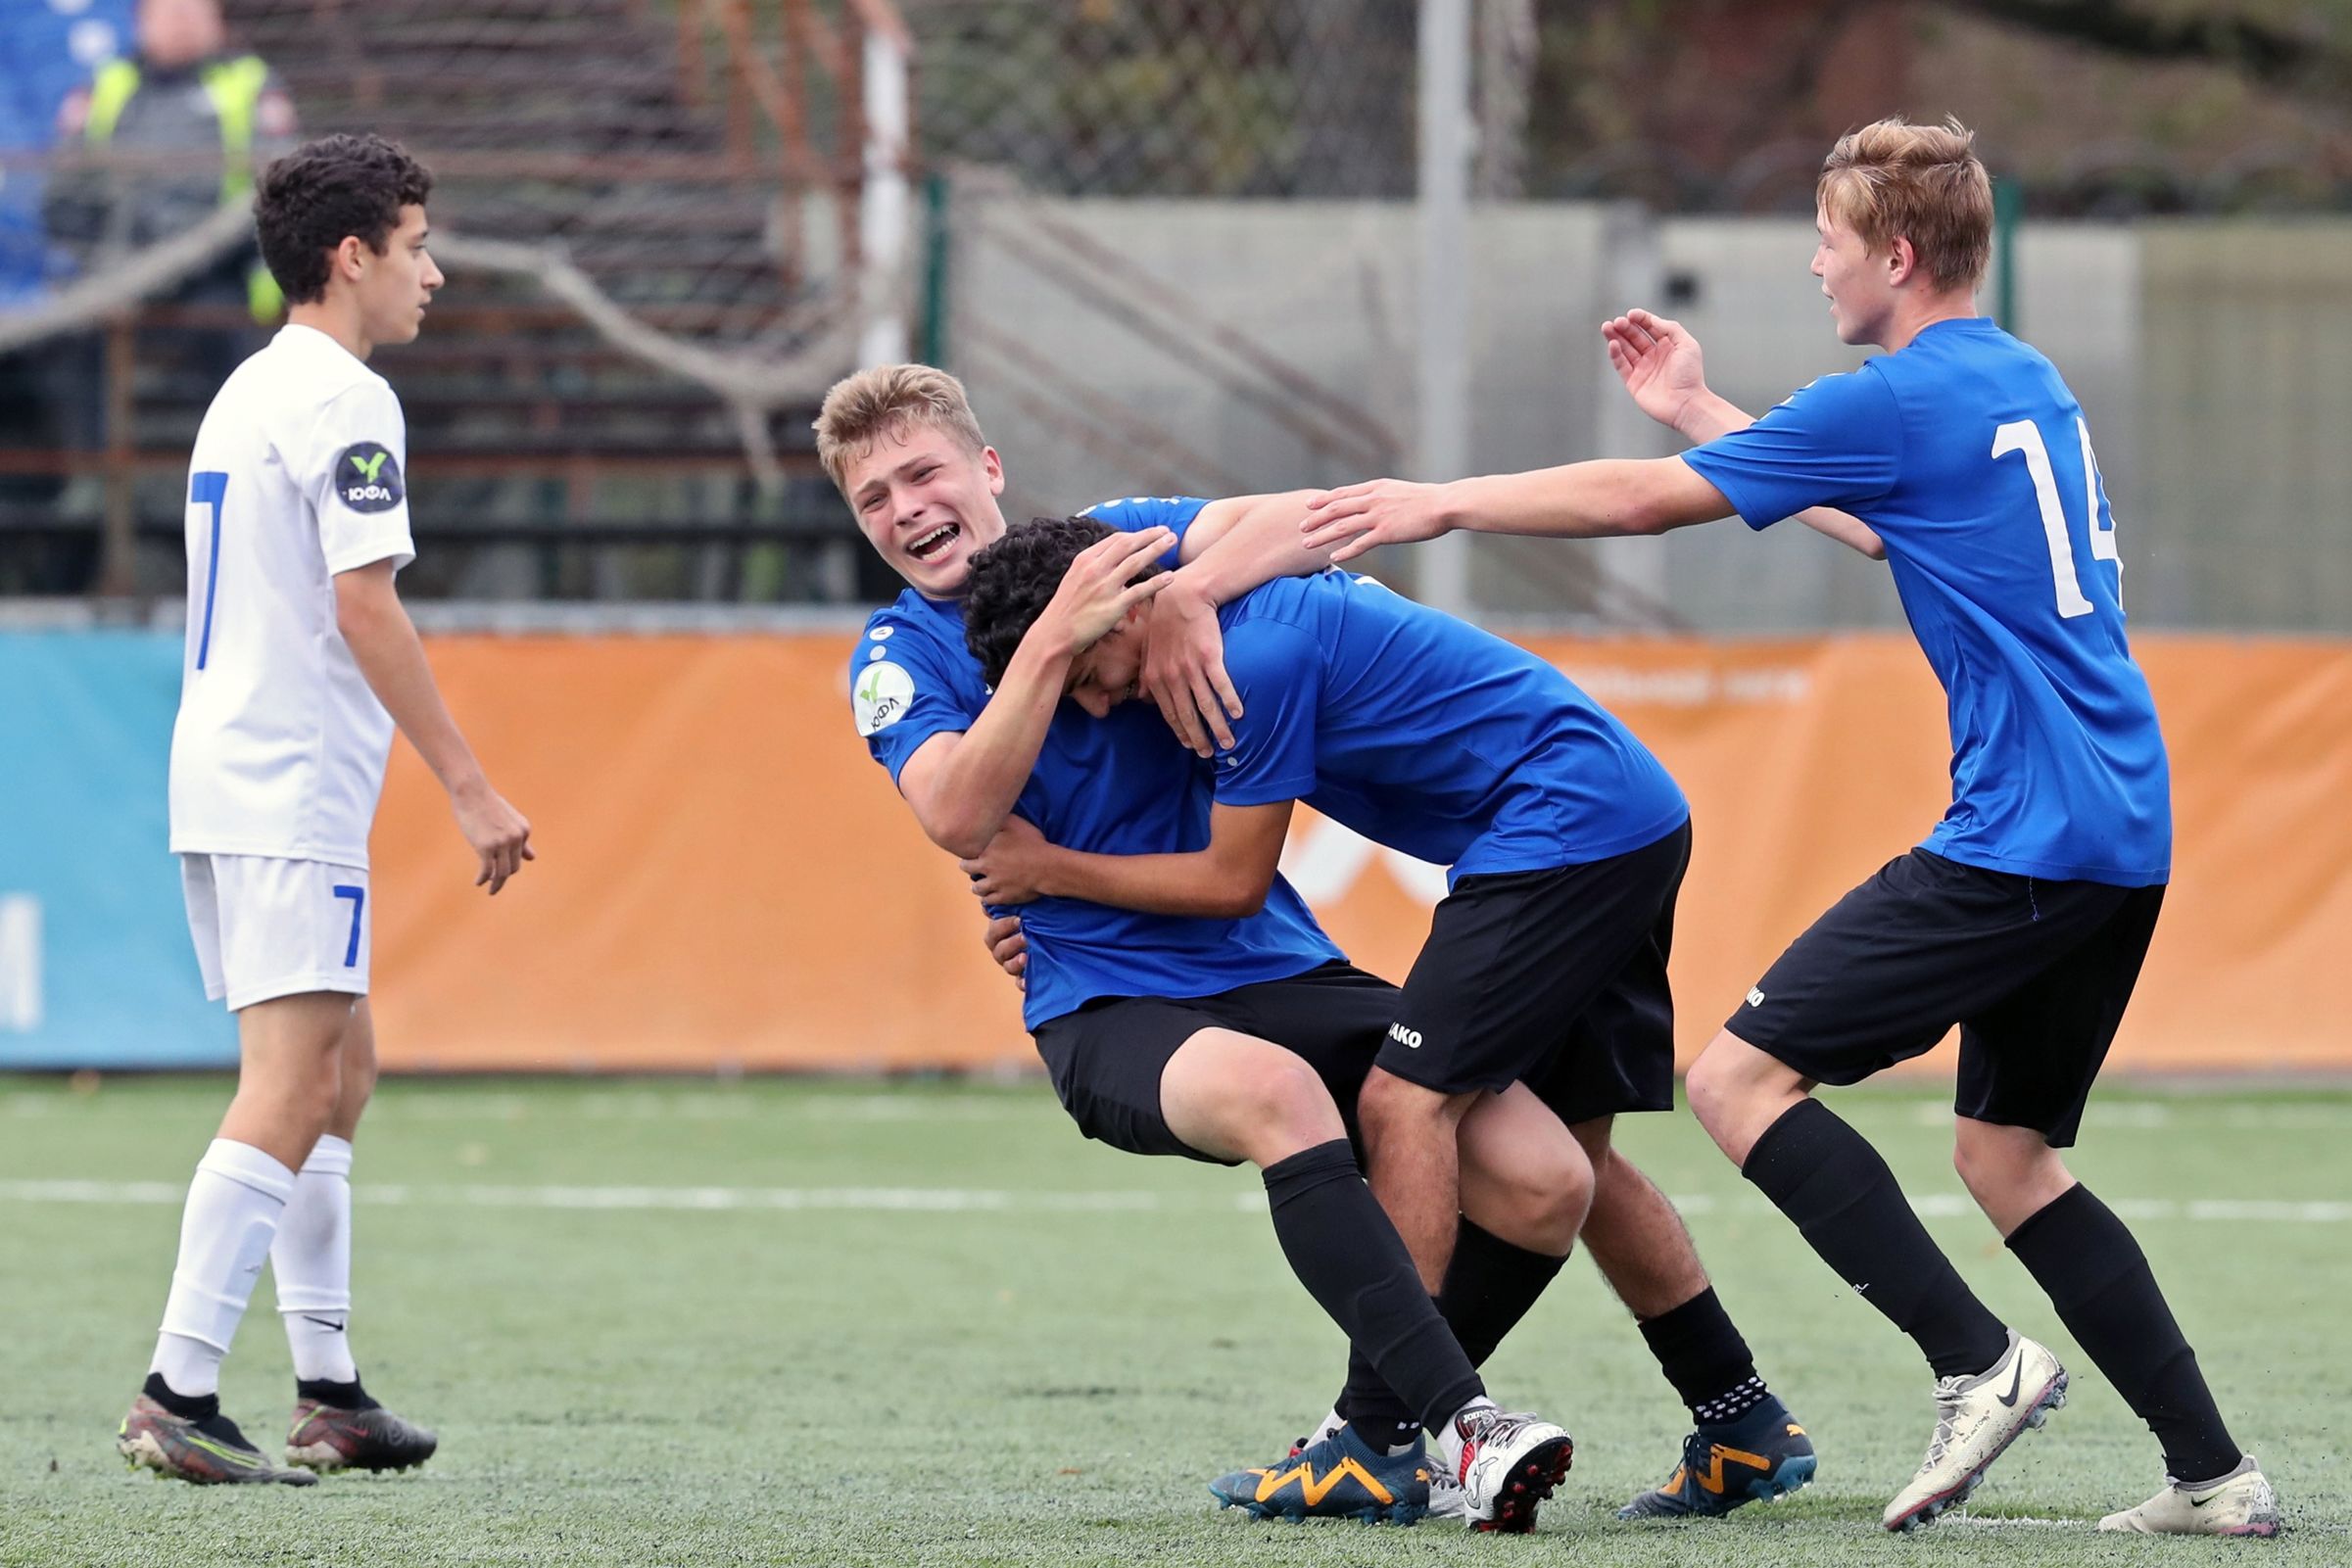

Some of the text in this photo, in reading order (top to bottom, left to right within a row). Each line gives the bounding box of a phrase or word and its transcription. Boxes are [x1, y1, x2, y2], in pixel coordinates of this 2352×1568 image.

[348, 485, 392, 501] ЮФЛ
[191, 472, 229, 671] 7
[334, 884, 364, 967] 7
[1388, 1022, 1422, 1049] AKO
